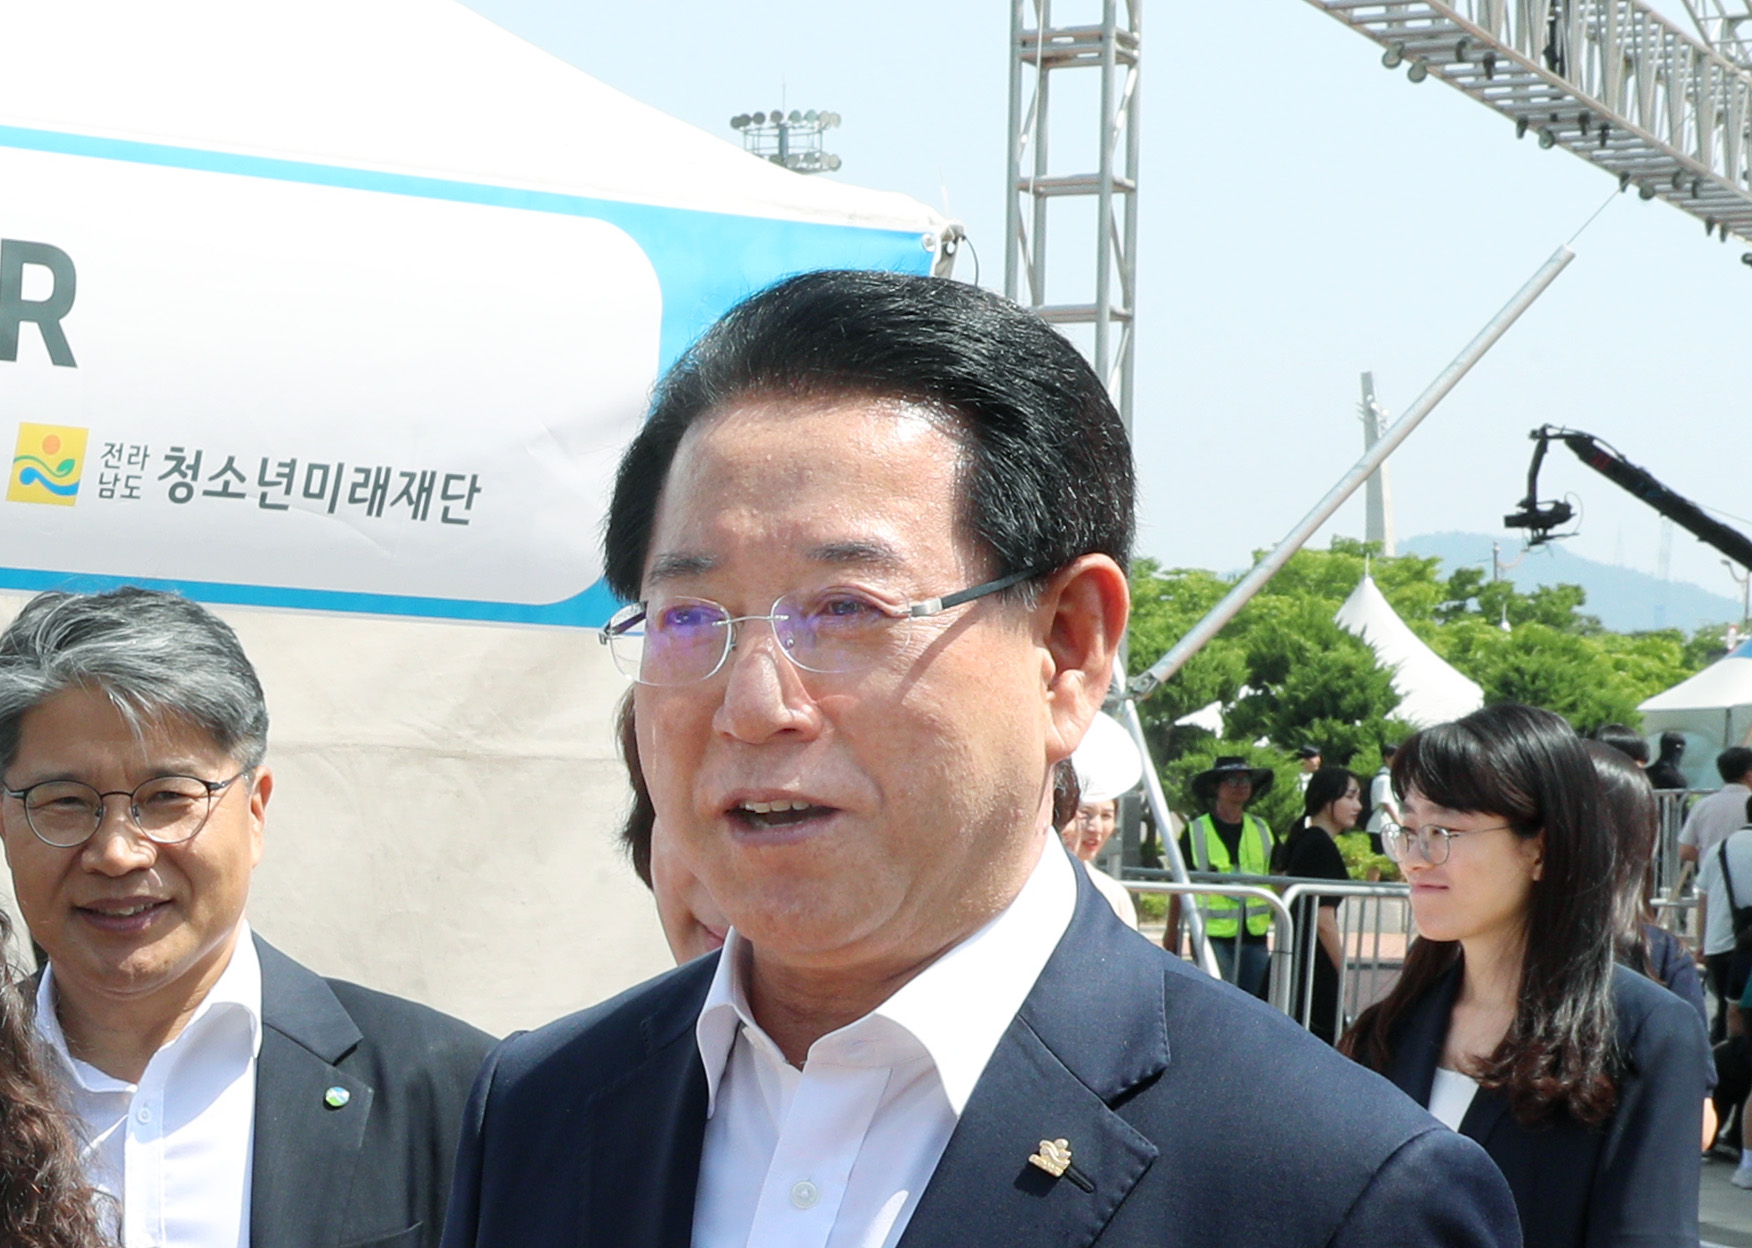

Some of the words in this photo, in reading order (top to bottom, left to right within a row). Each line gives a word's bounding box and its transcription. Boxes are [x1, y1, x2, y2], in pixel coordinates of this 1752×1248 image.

[99, 441, 151, 472] 전라
[98, 472, 143, 502] 남도
[157, 446, 483, 526] 청소년미래재단
